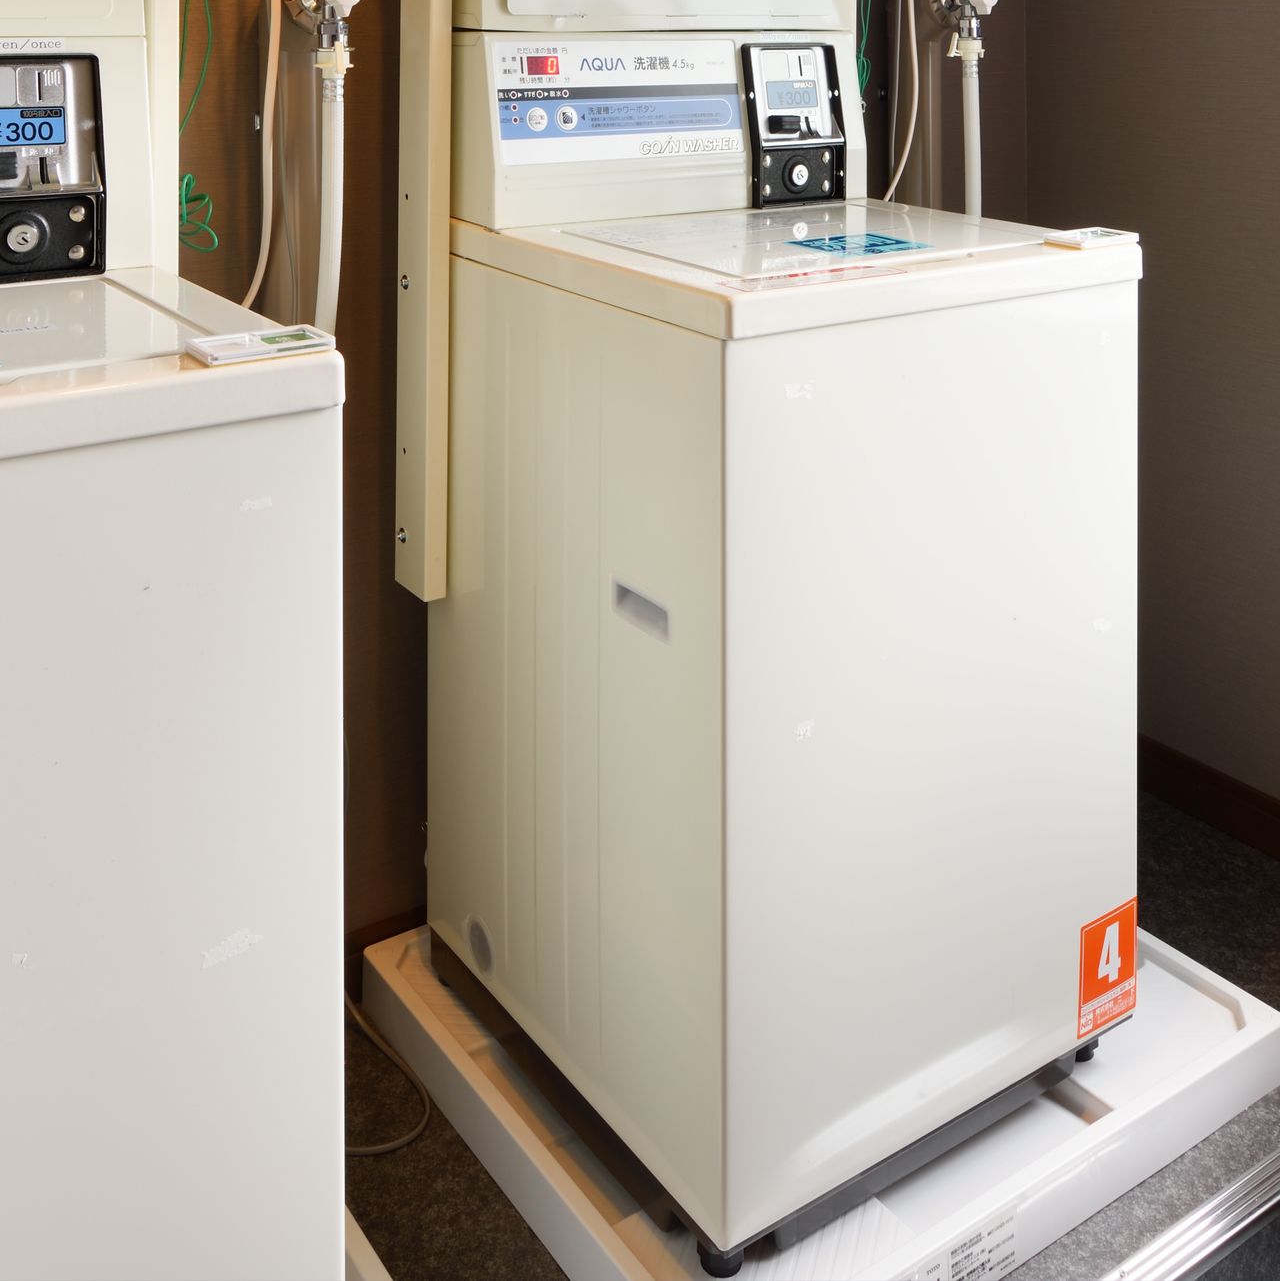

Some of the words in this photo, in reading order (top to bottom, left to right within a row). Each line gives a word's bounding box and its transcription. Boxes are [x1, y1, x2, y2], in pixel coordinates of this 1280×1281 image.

[580, 57, 626, 72] AQUA
[633, 56, 671, 71] 洗濯機
[683, 136, 739, 153] WASHER
[1097, 921, 1122, 984] 4
